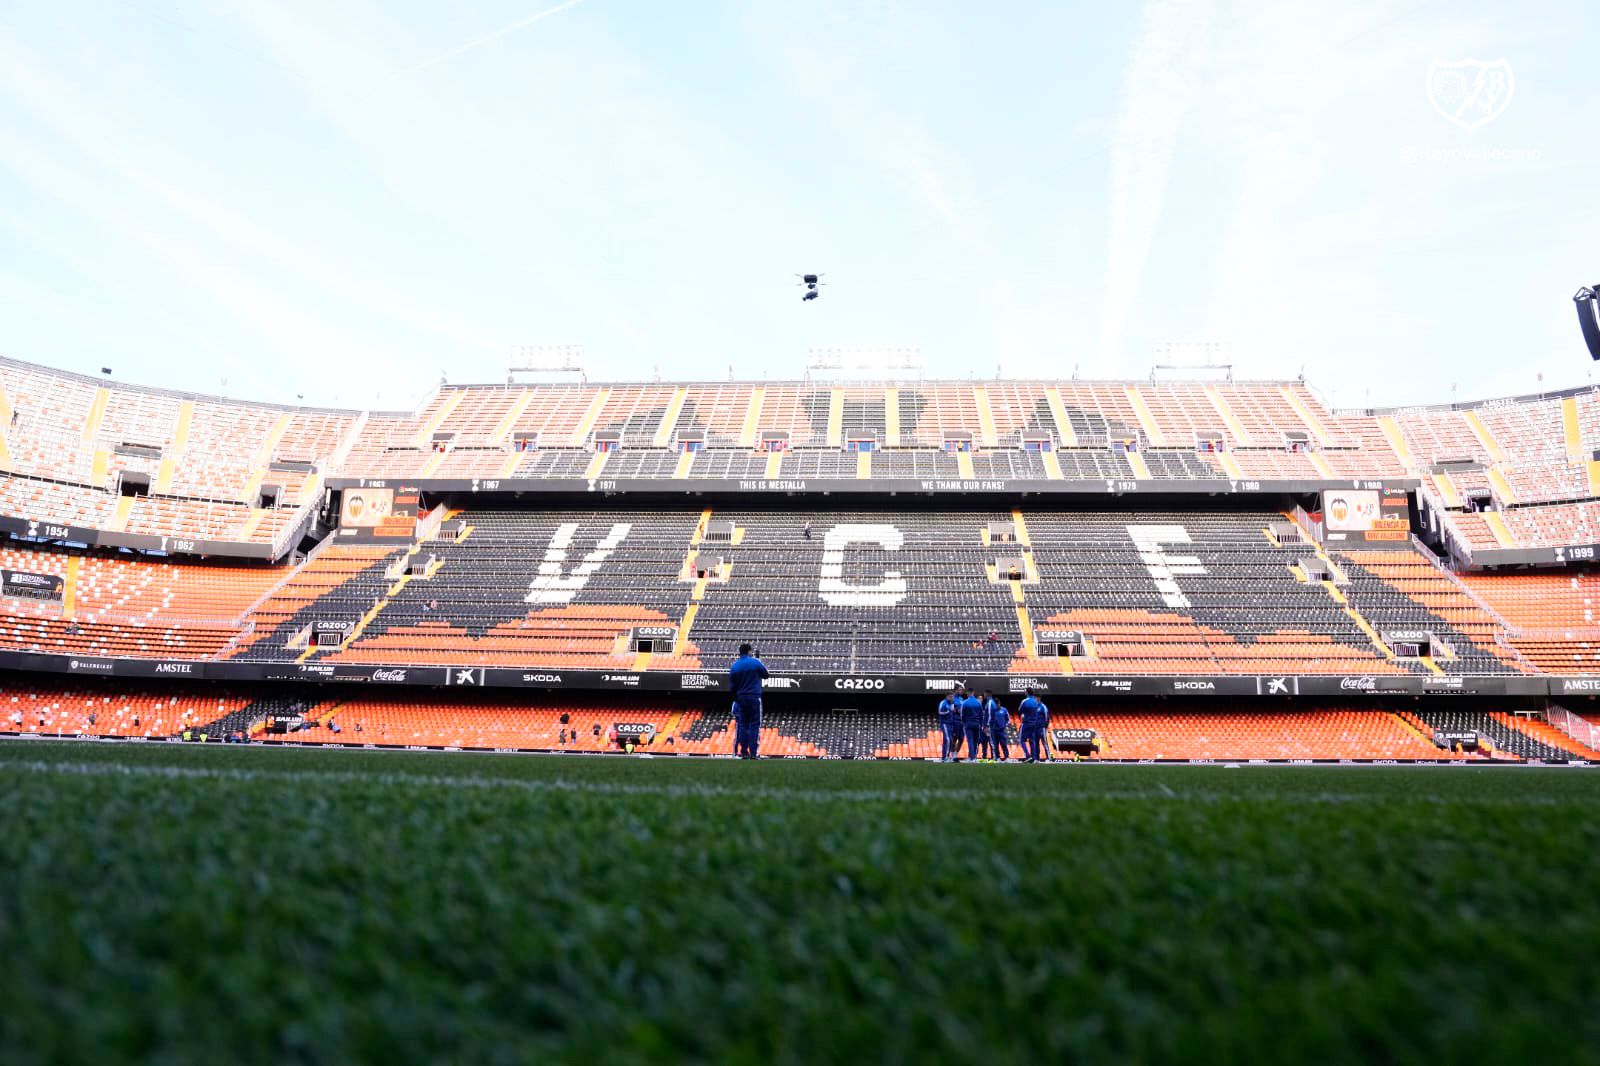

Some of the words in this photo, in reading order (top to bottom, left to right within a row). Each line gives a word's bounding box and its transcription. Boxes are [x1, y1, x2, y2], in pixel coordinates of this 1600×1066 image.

[482, 481, 500, 489] 1967
[600, 481, 616, 489] 1971
[739, 481, 758, 489] THIS
[759, 481, 766, 489] IS
[768, 481, 806, 489] MESTALLA
[921, 481, 934, 490] WE
[936, 481, 961, 490] THANK
[964, 481, 980, 490] OUR
[982, 481, 1005, 490] FANS!
[1241, 482, 1260, 490] 1980
[45, 525, 69, 539] 1954
[173, 539, 194, 552] 1962
[1569, 547, 1594, 559] 1999
[818, 523, 907, 607] C
[1126, 524, 1208, 608] F
[317, 622, 347, 630] CAZOO
[639, 627, 671, 635] CAZOO
[1041, 631, 1074, 639] CAZOO
[1390, 631, 1423, 639] CAZOO
[155, 663, 192, 673] AMSTEL
[761, 678, 791, 688] PUMA
[834, 679, 885, 689] CAZOO
[925, 679, 954, 690] PUMA
[1563, 680, 1600, 690] AMSTE
[617, 724, 651, 732] CAZOO
[1056, 730, 1091, 738] CAZOO
